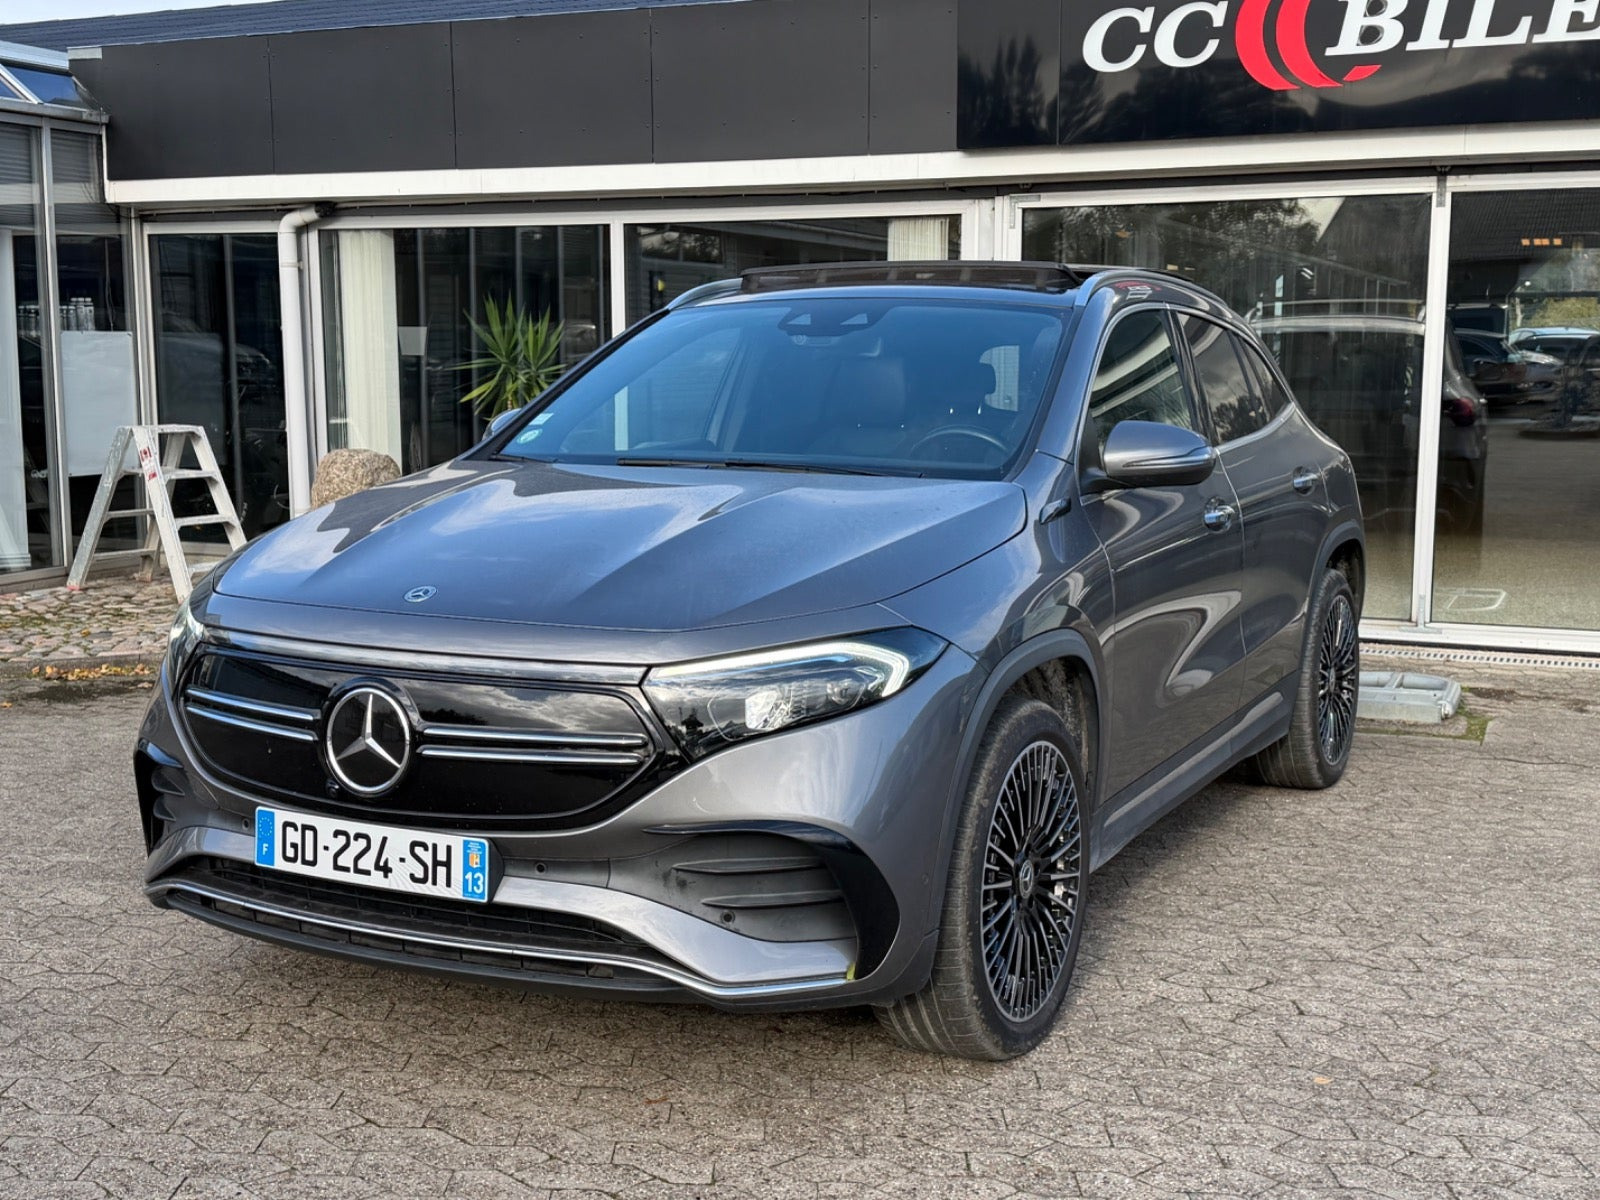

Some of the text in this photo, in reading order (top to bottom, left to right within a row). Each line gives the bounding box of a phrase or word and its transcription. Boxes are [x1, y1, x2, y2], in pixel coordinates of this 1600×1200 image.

[1082, 1, 1229, 73] CC
[262, 843, 269, 856] F
[281, 820, 452, 888] GD-224-SH
[464, 871, 484, 894] 13
